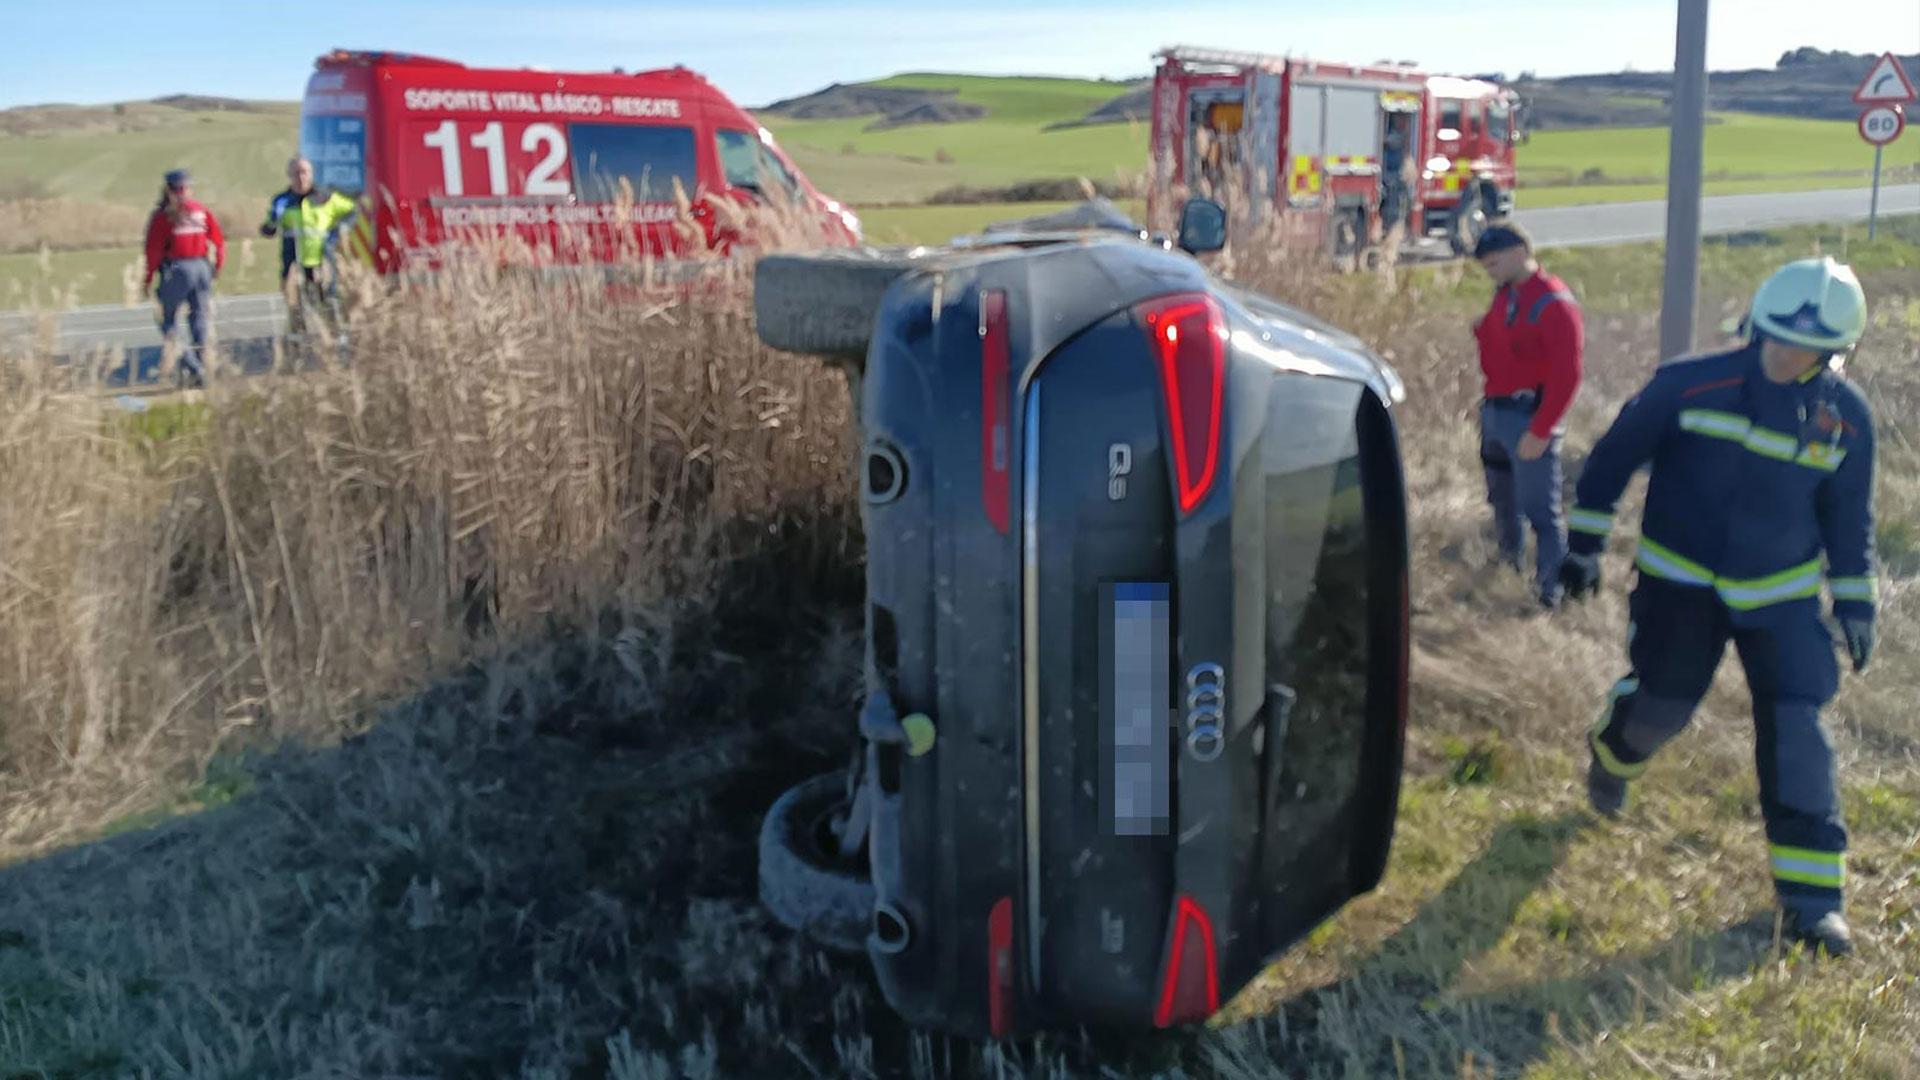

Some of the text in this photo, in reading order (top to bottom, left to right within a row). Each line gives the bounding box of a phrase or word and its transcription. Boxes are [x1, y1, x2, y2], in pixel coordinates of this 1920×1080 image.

[404, 87, 493, 112] SOPORTE
[492, 91, 541, 113] VITAL
[540, 89, 603, 115] BÁSICO
[611, 96, 681, 119] RESCATE
[1868, 117, 1894, 131] 80
[423, 120, 571, 196] 112
[1108, 443, 1132, 500] Q5
